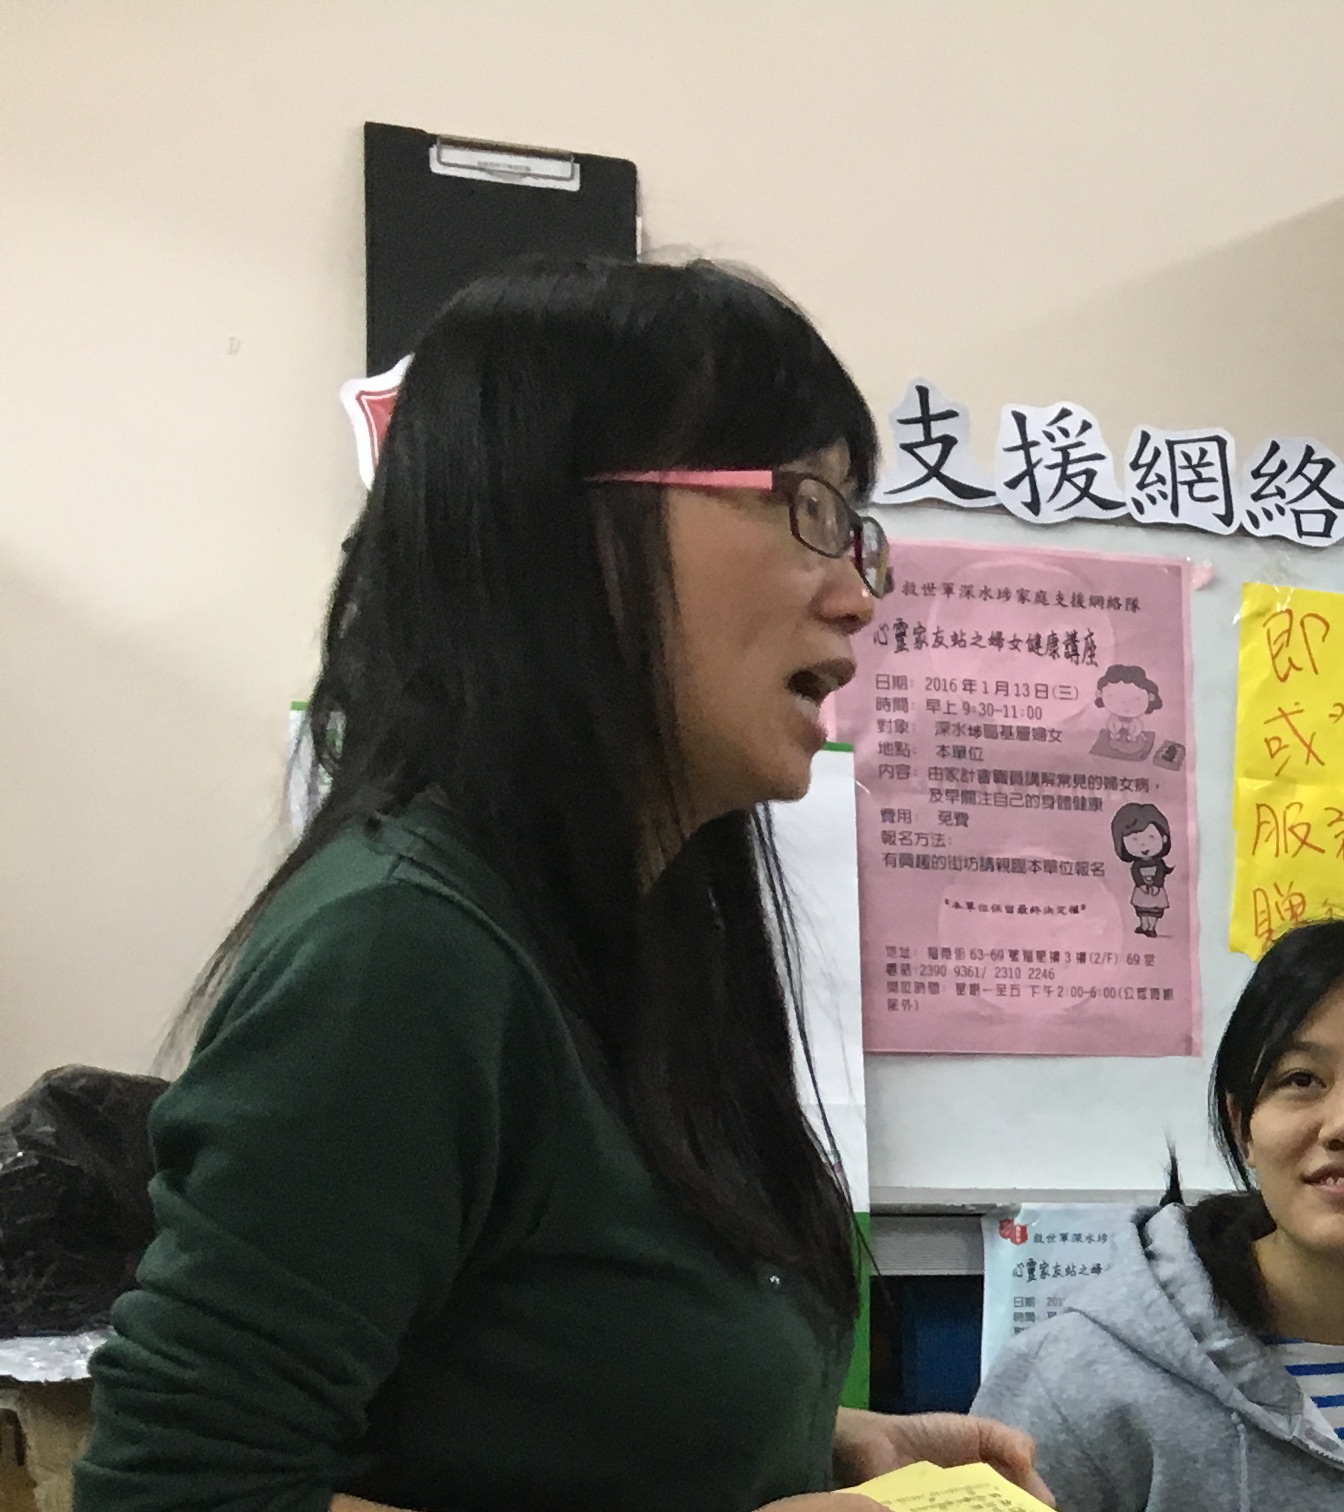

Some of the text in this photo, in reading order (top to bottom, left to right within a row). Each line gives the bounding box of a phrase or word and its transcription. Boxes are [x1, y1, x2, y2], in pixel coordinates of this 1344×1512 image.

[872, 617, 1100, 667] 心靈家友站之婦女健康講座
[936, 743, 985, 762] 本單位
[938, 810, 970, 828] 免費
[993, 964, 1022, 979] 2310
[1028, 965, 1056, 980] 2246
